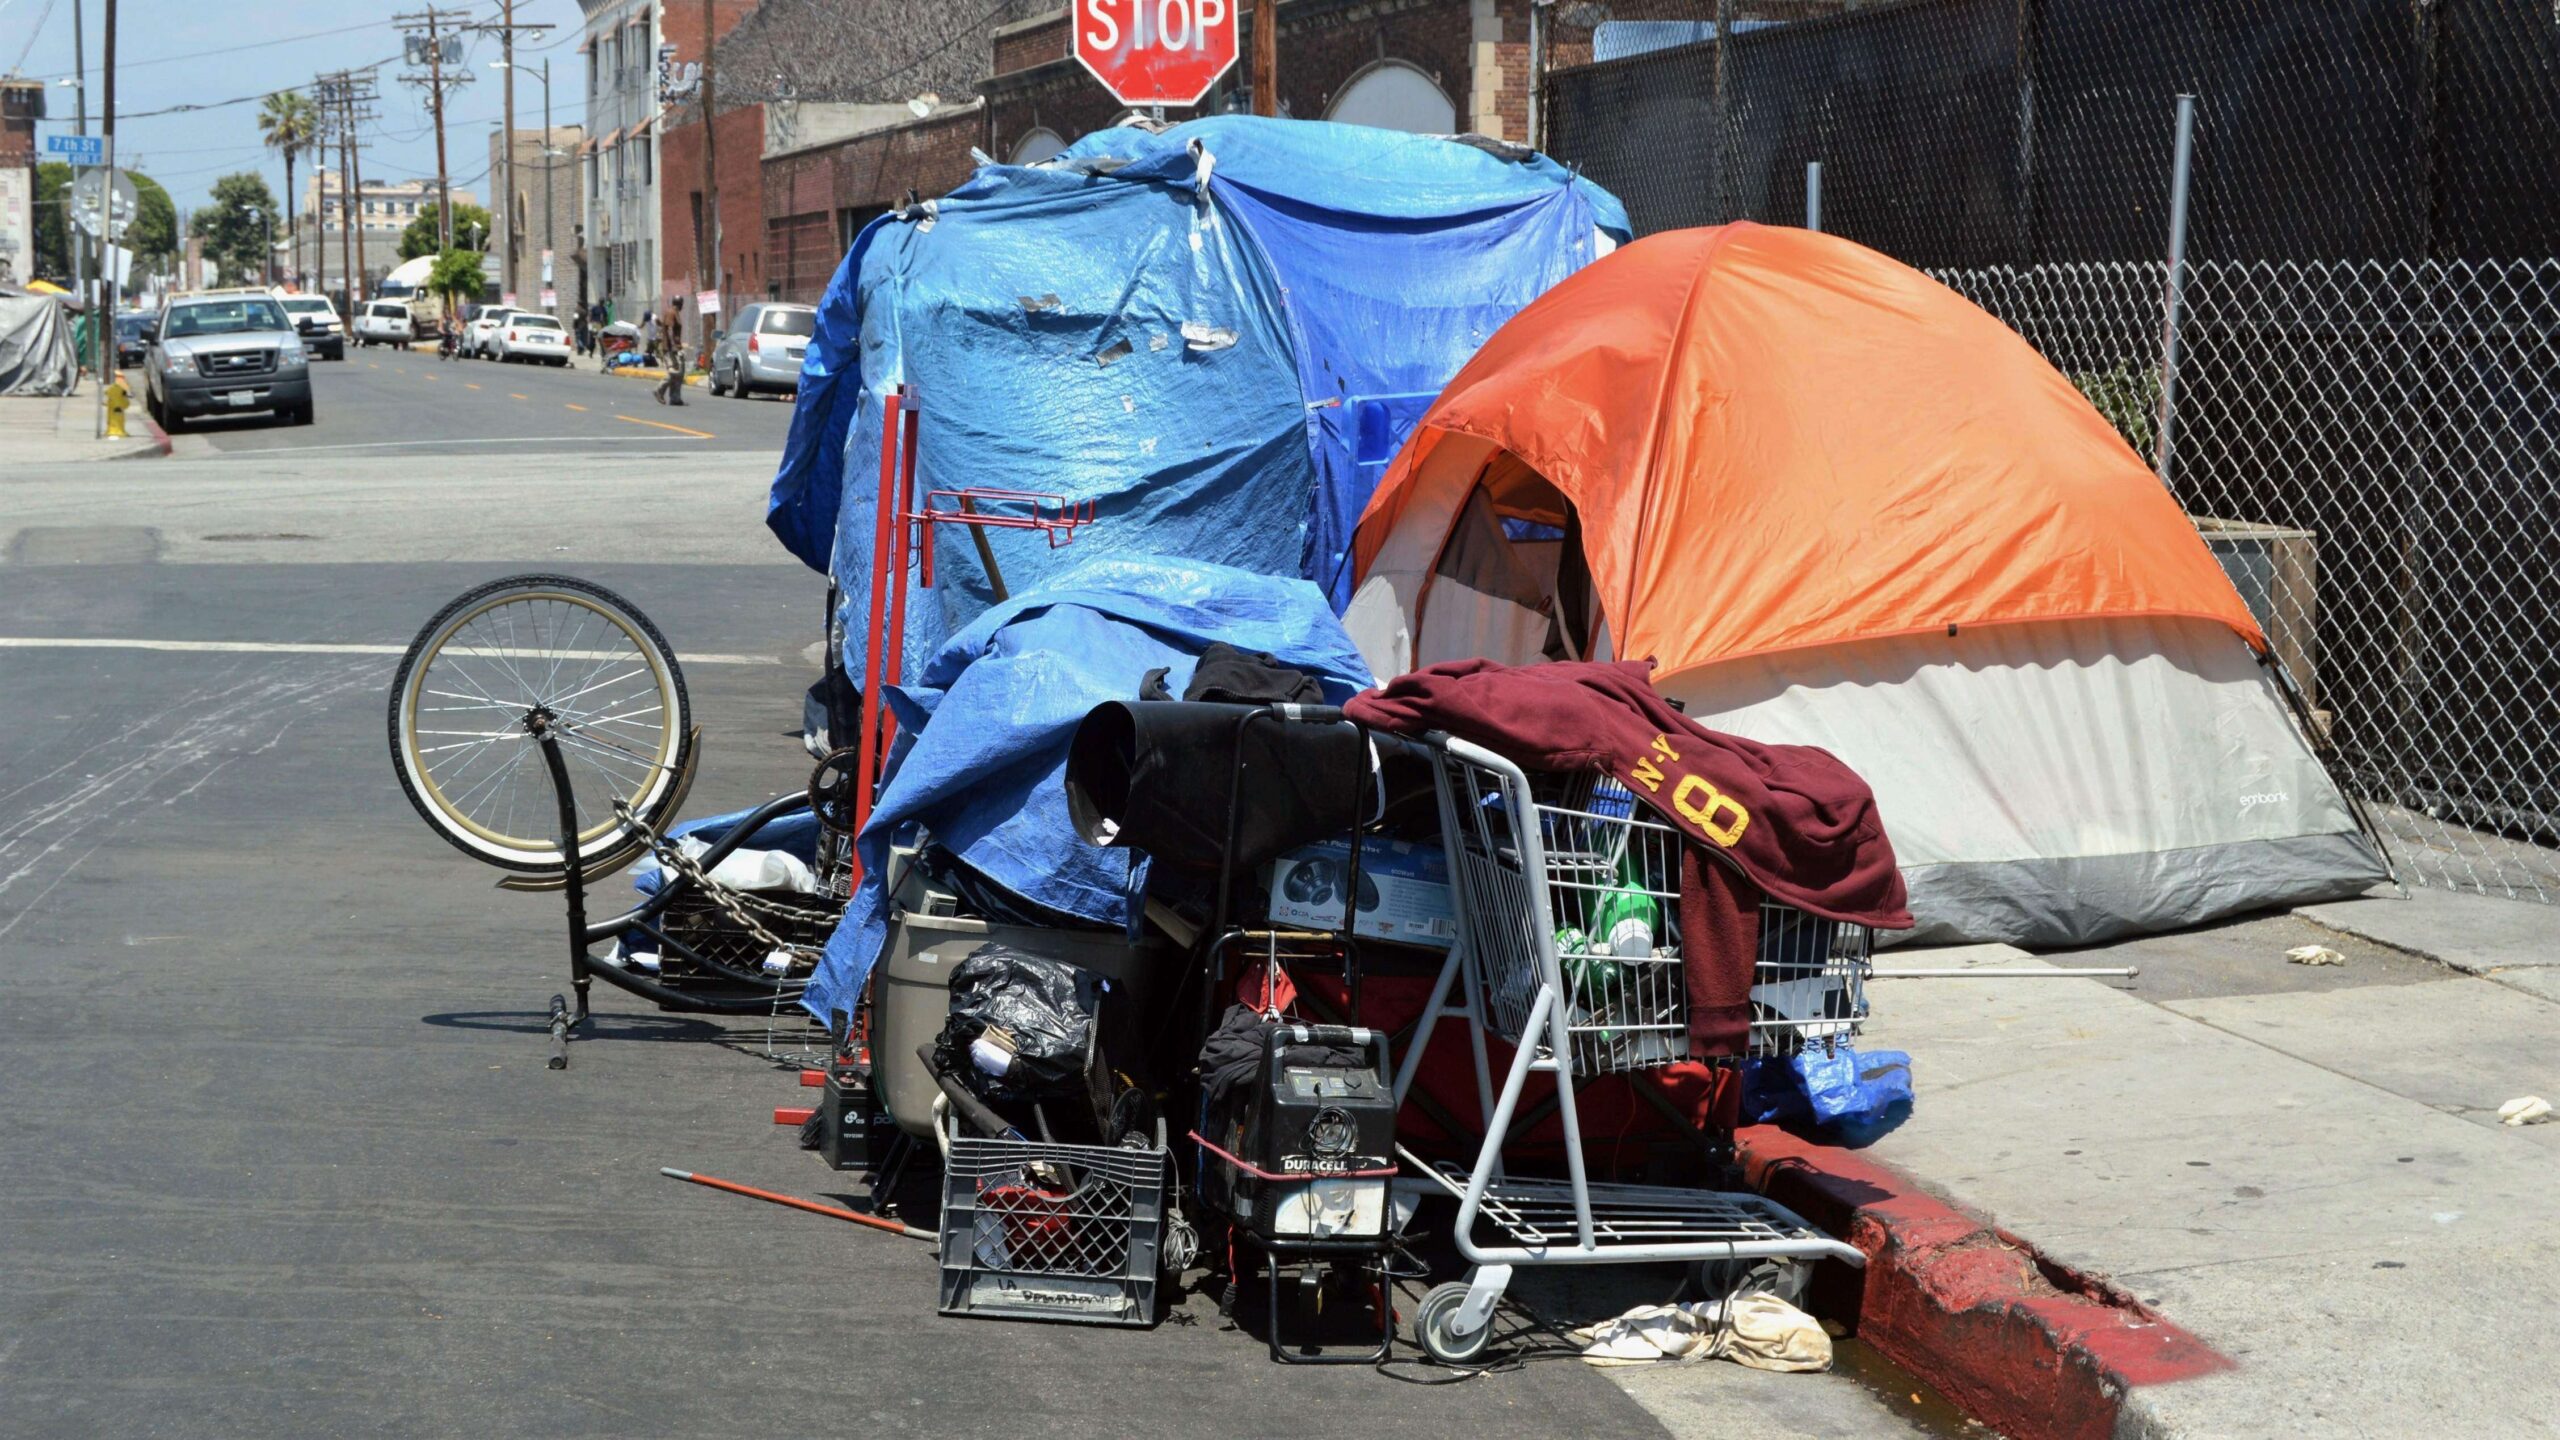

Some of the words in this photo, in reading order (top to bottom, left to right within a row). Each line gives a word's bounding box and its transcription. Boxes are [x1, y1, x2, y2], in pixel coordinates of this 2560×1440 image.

[1087, 0, 1225, 51] STOP
[54, 138, 78, 150] 7th
[82, 139, 95, 151] St
[1672, 774, 1750, 848] 8
[1284, 1159, 1348, 1172] DURACELL
